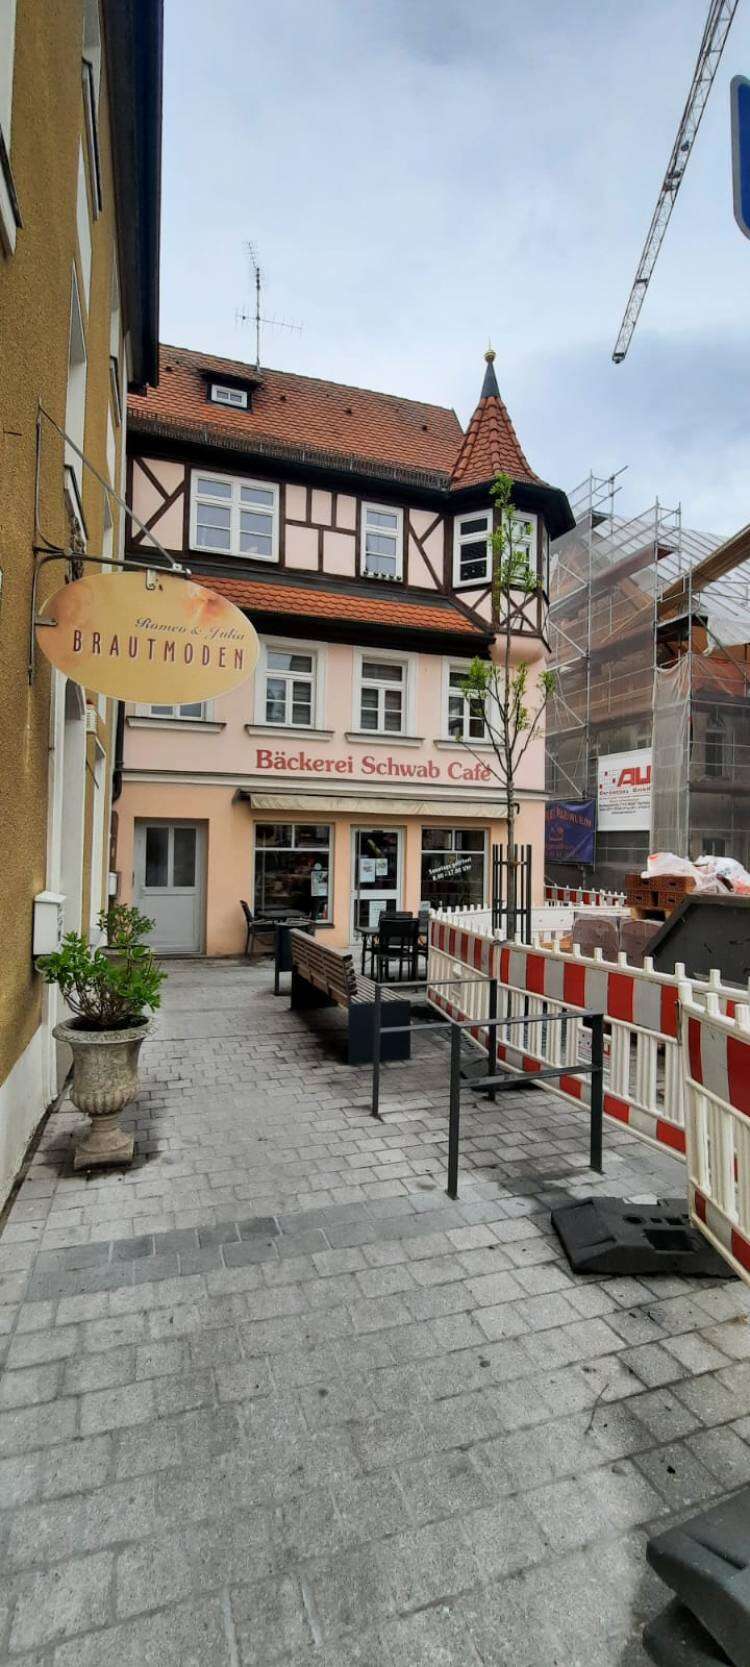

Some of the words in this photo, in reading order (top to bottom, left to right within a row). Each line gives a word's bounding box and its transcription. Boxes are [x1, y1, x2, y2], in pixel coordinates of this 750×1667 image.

[135, 617, 187, 633] Romeo
[190, 626, 202, 635] &
[204, 626, 246, 641] Julia
[73, 629, 245, 670] BRAUTMODEN
[256, 748, 353, 774] Bäckerei
[360, 755, 440, 779] Schwab
[447, 761, 492, 782] Café
